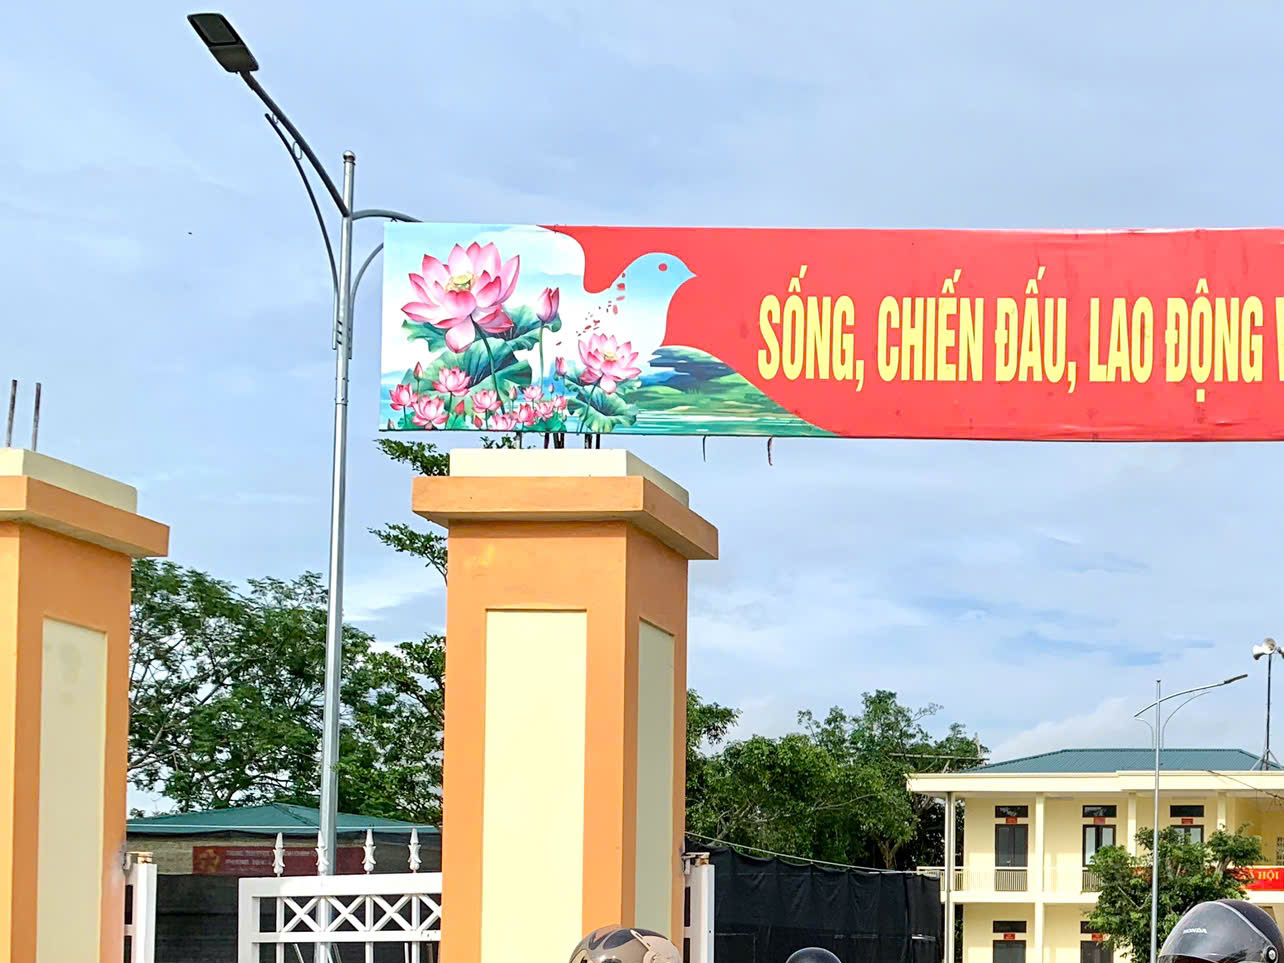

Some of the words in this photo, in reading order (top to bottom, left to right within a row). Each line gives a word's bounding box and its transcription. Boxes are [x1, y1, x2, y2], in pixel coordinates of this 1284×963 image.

[757, 265, 865, 392] SỐNG,
[877, 269, 985, 382] CHIẾN
[995, 267, 1077, 394] ĐẤU,
[1089, 296, 1154, 383] LAO
[1165, 278, 1264, 402] ĐỘNG
